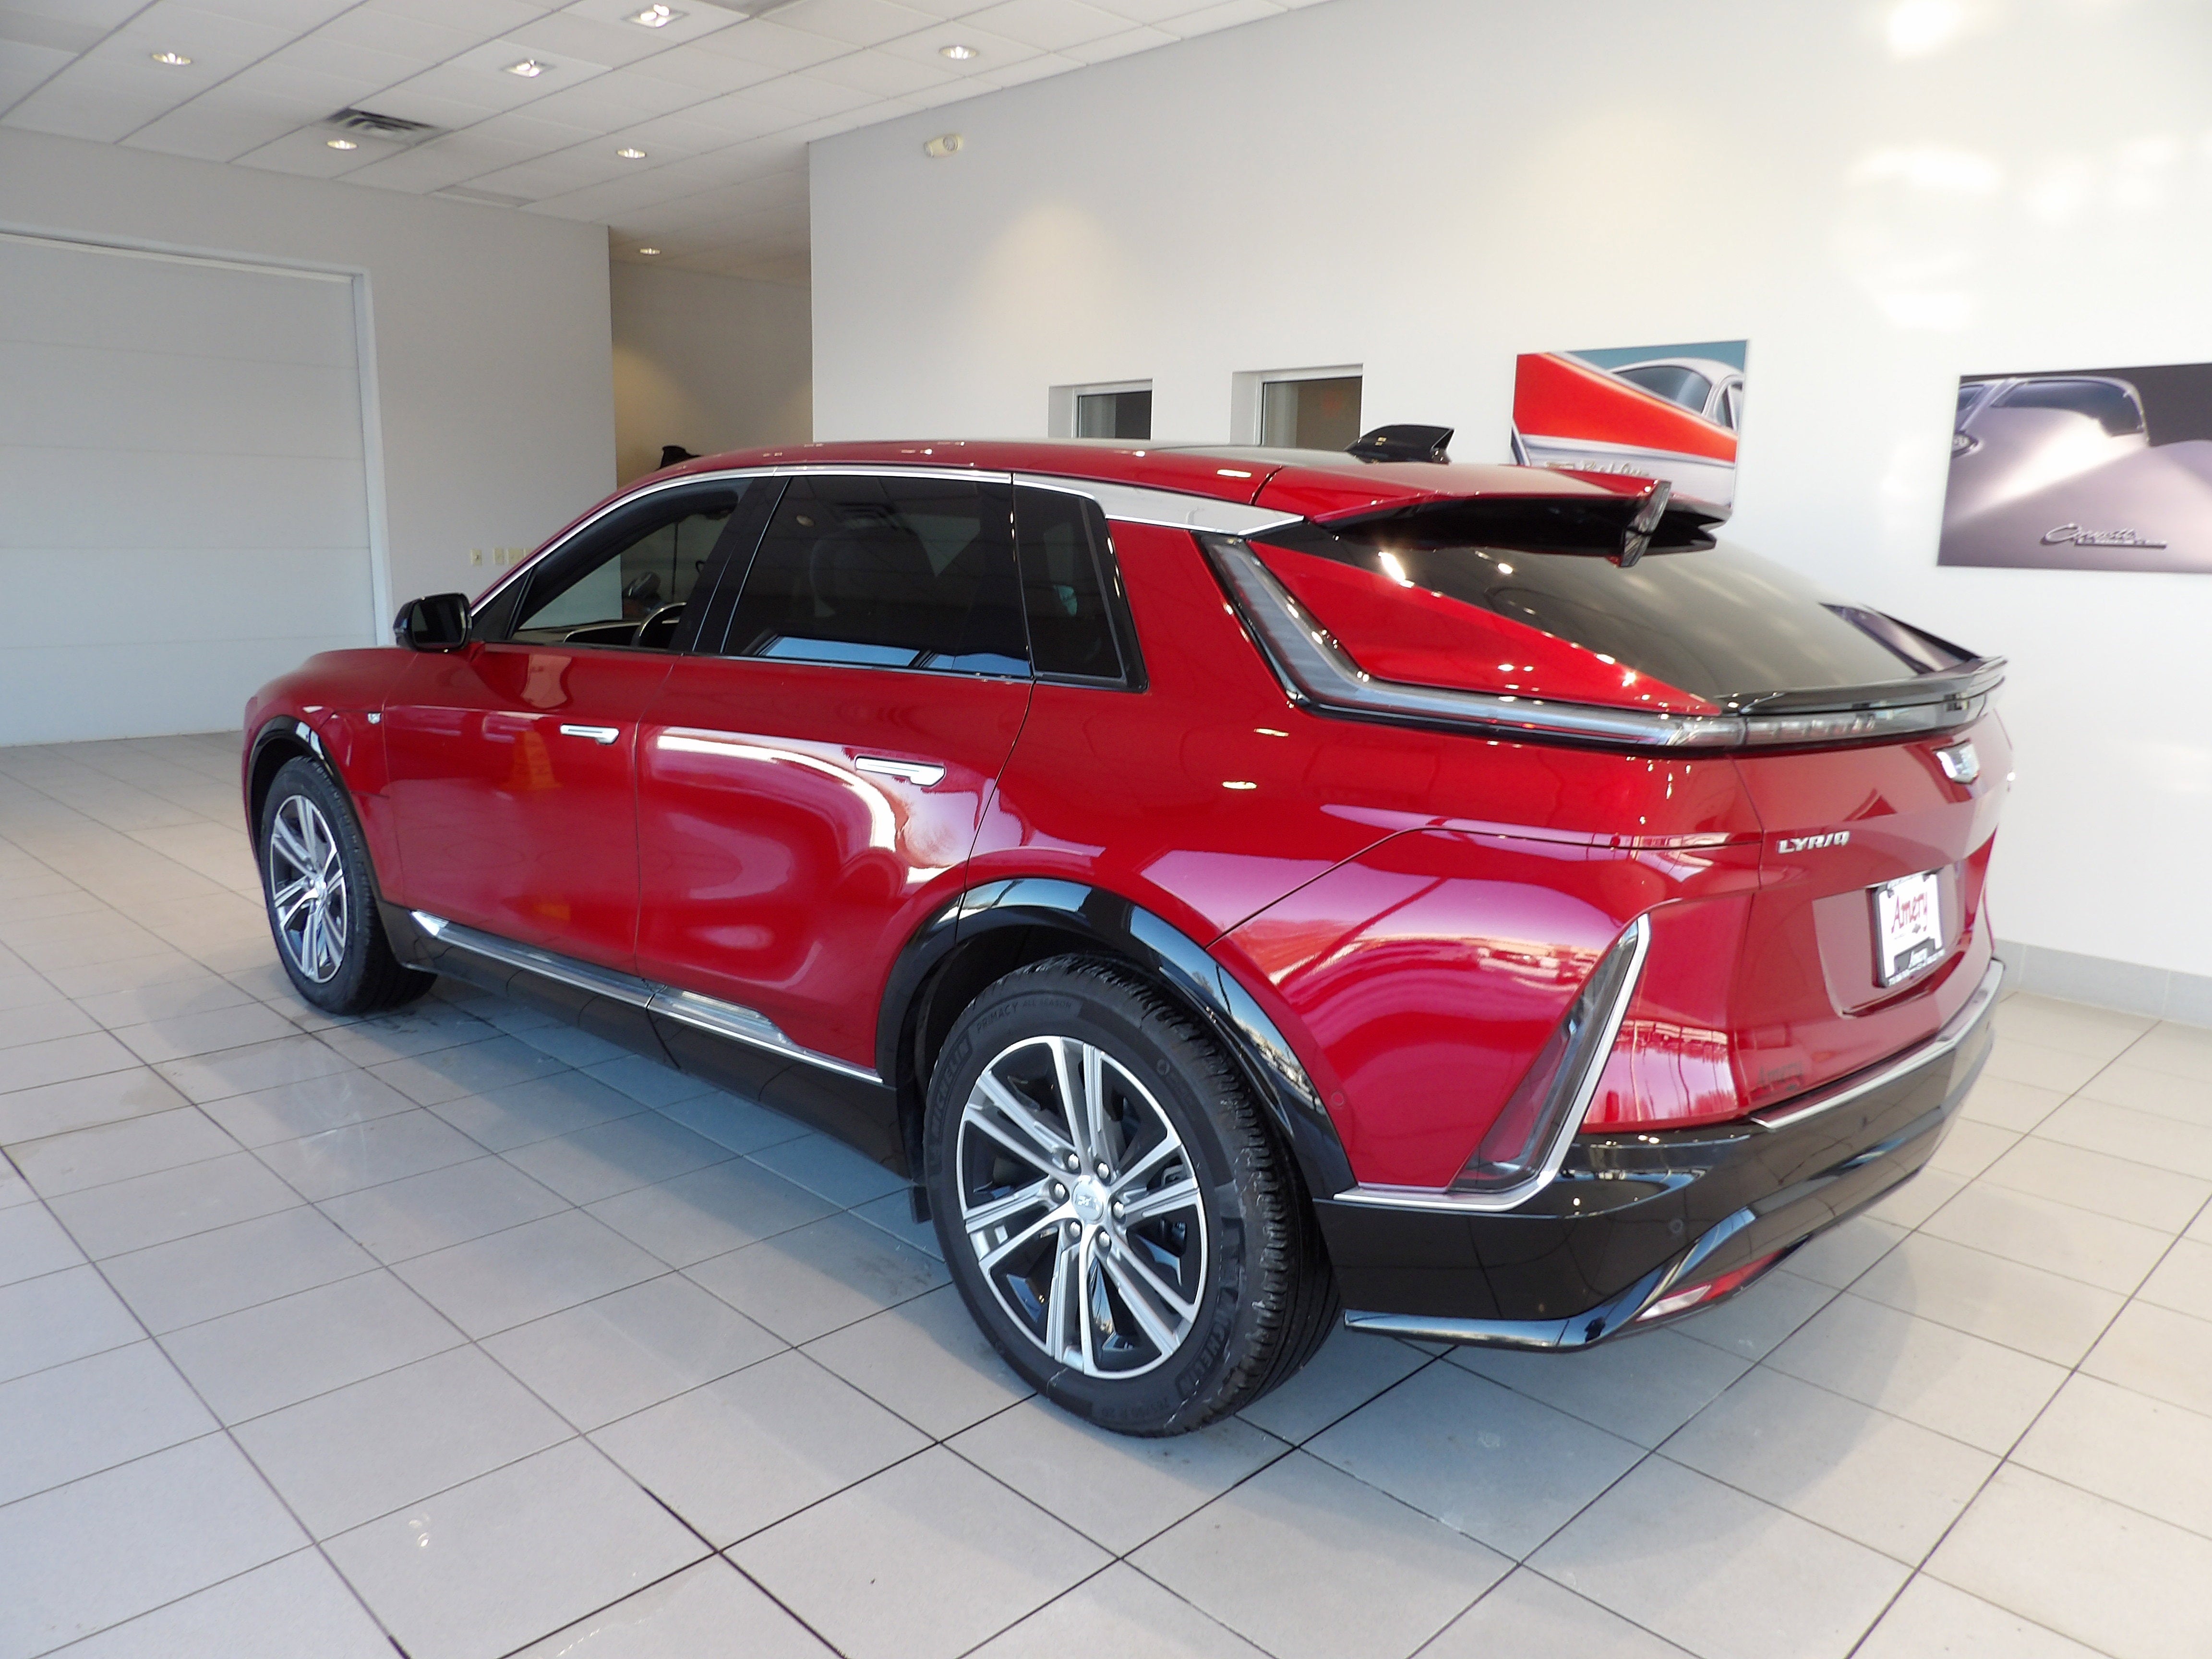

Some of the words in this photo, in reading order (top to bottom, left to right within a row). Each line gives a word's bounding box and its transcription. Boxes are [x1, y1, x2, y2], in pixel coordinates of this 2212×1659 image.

[1778, 830, 1851, 854] LYRIQ
[1891, 891, 1928, 934] Amery
[976, 1001, 1018, 1033] PRIMACY
[1022, 999, 1037, 1008] ALL
[1039, 998, 1072, 1009] SEASON
[930, 1037, 970, 1139] MICHELIN
